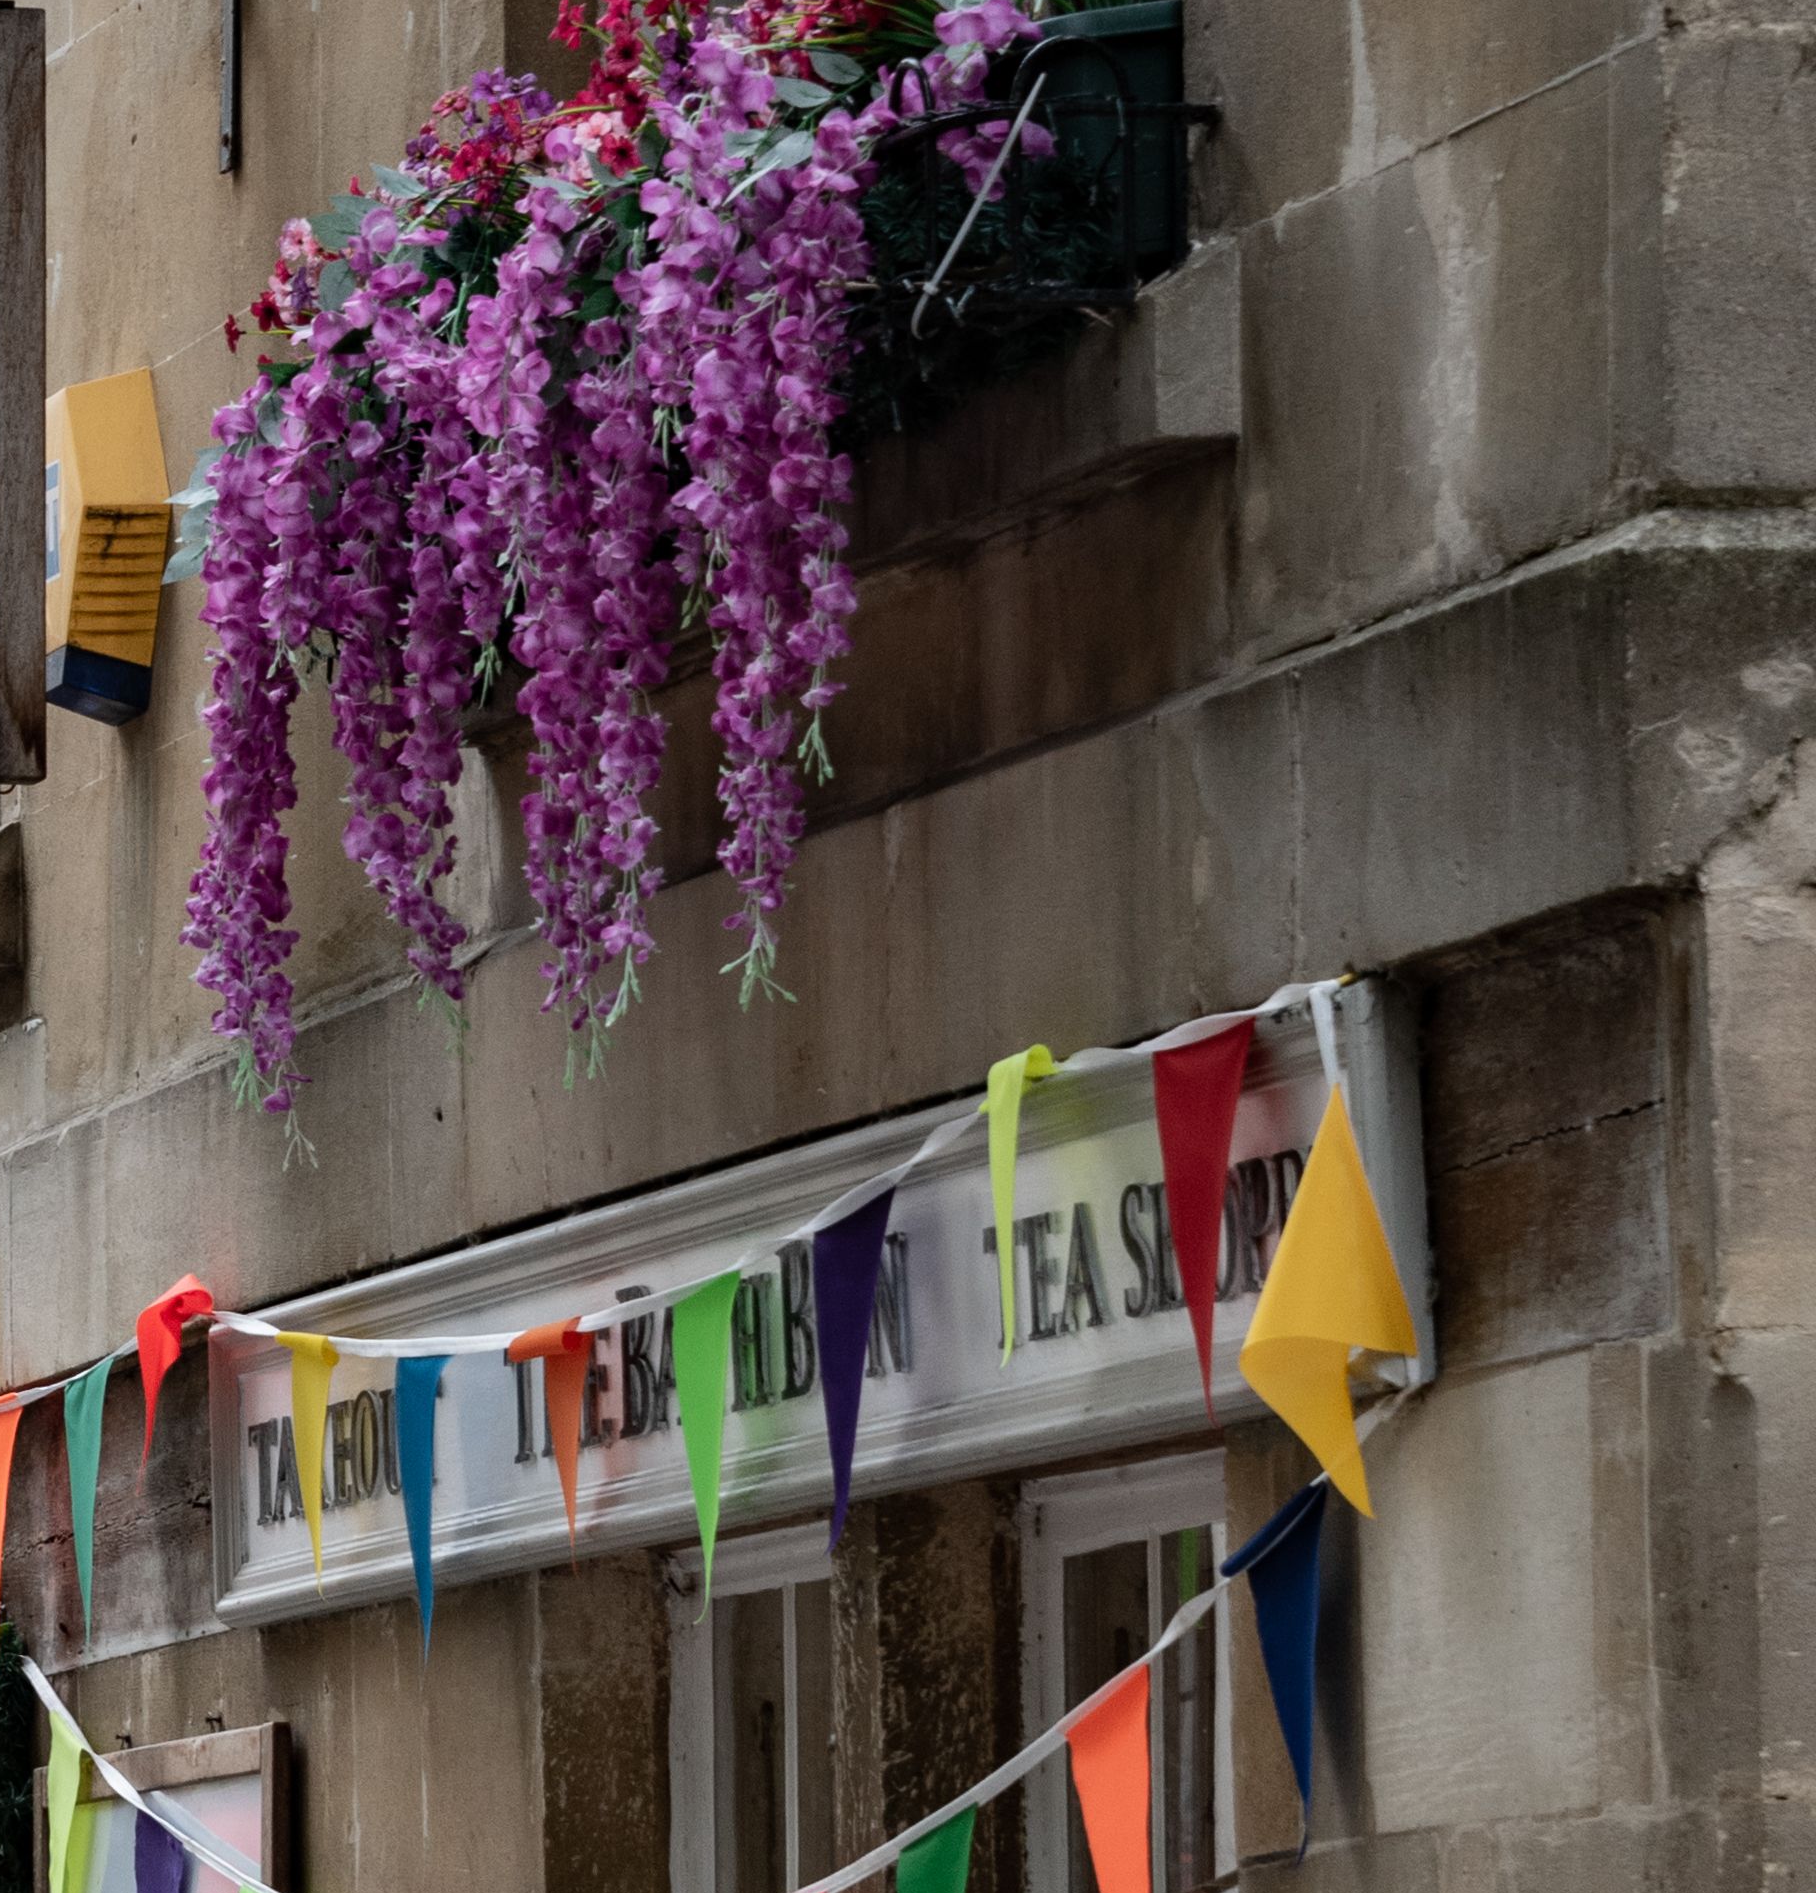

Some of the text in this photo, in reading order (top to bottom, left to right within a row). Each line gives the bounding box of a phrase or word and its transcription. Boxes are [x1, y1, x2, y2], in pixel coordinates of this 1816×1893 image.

[248, 1375, 444, 1526] TAEOU
[504, 1325, 612, 1465] TE
[615, 1272, 774, 1440] BAH
[775, 1231, 910, 1401] BN
